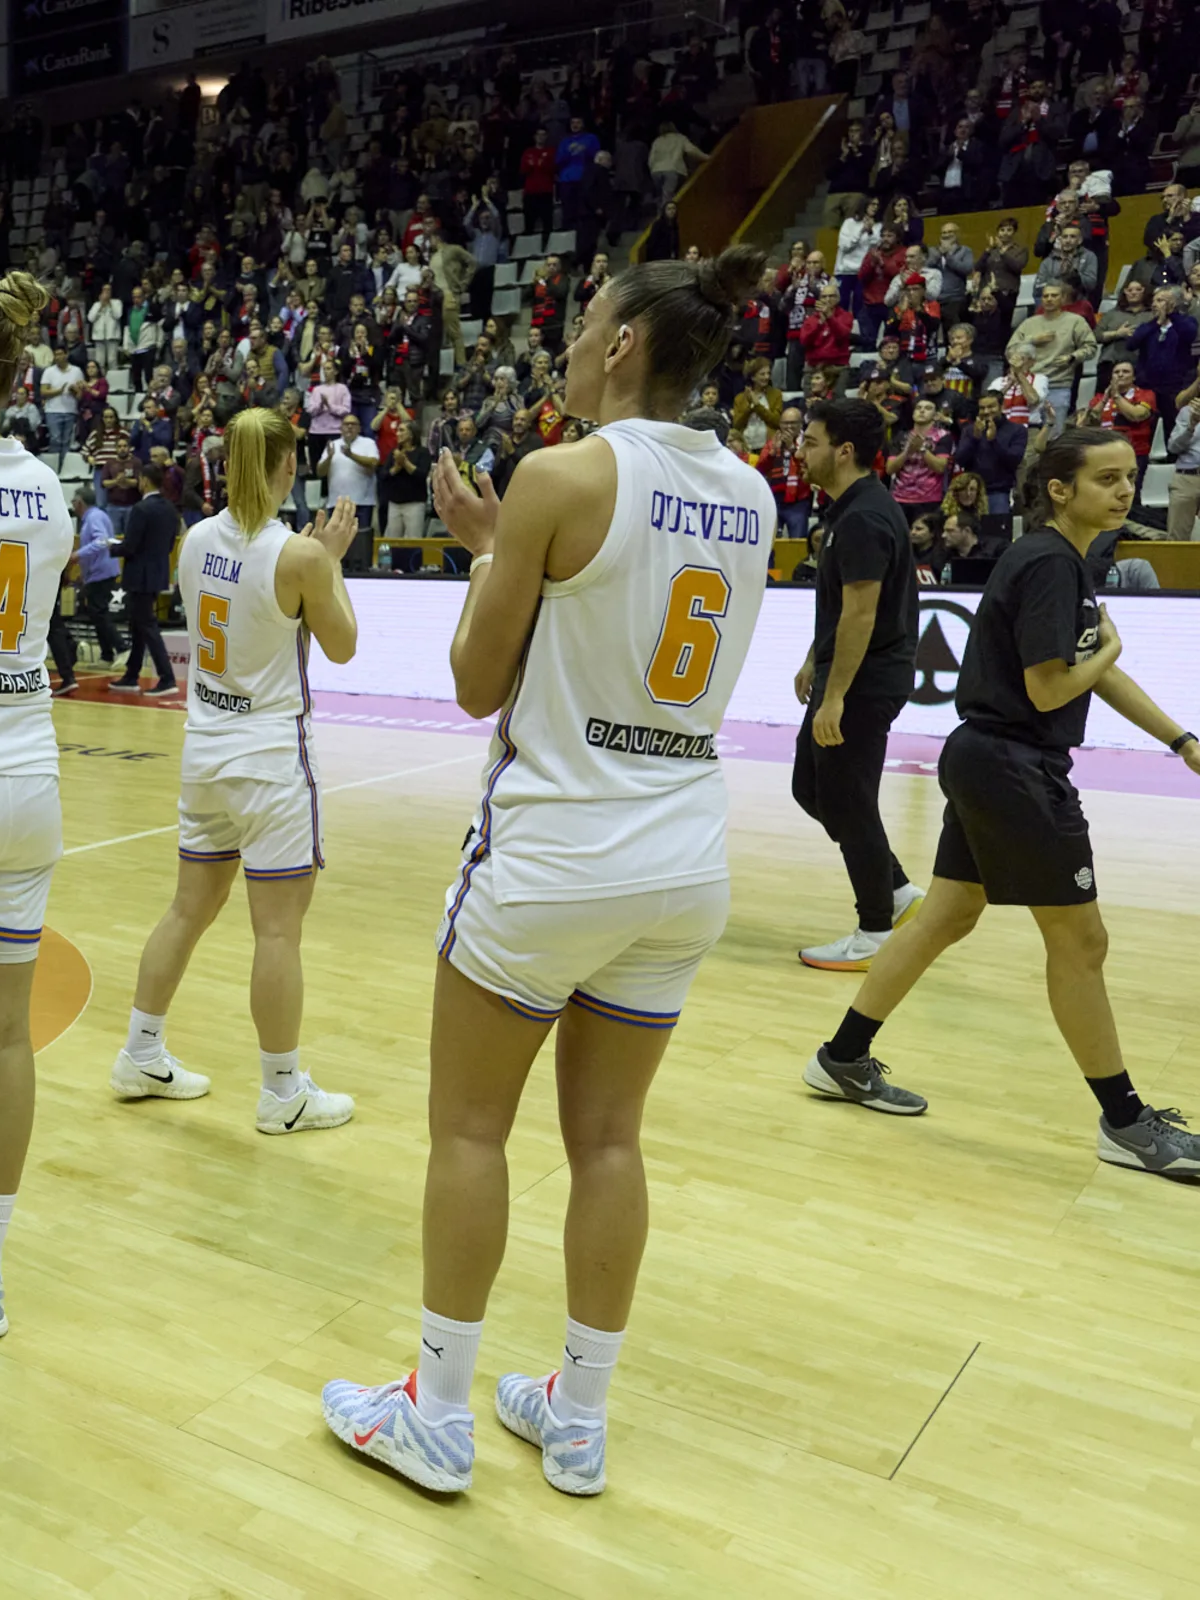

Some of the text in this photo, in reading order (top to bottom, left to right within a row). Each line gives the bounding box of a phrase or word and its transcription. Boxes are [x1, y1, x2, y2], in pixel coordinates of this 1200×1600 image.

[42, 43, 112, 72] CaixaBank
[651, 490, 759, 546] QUEVEDO
[202, 553, 243, 584] HOLM
[196, 590, 231, 678] 5
[645, 564, 732, 708] 6
